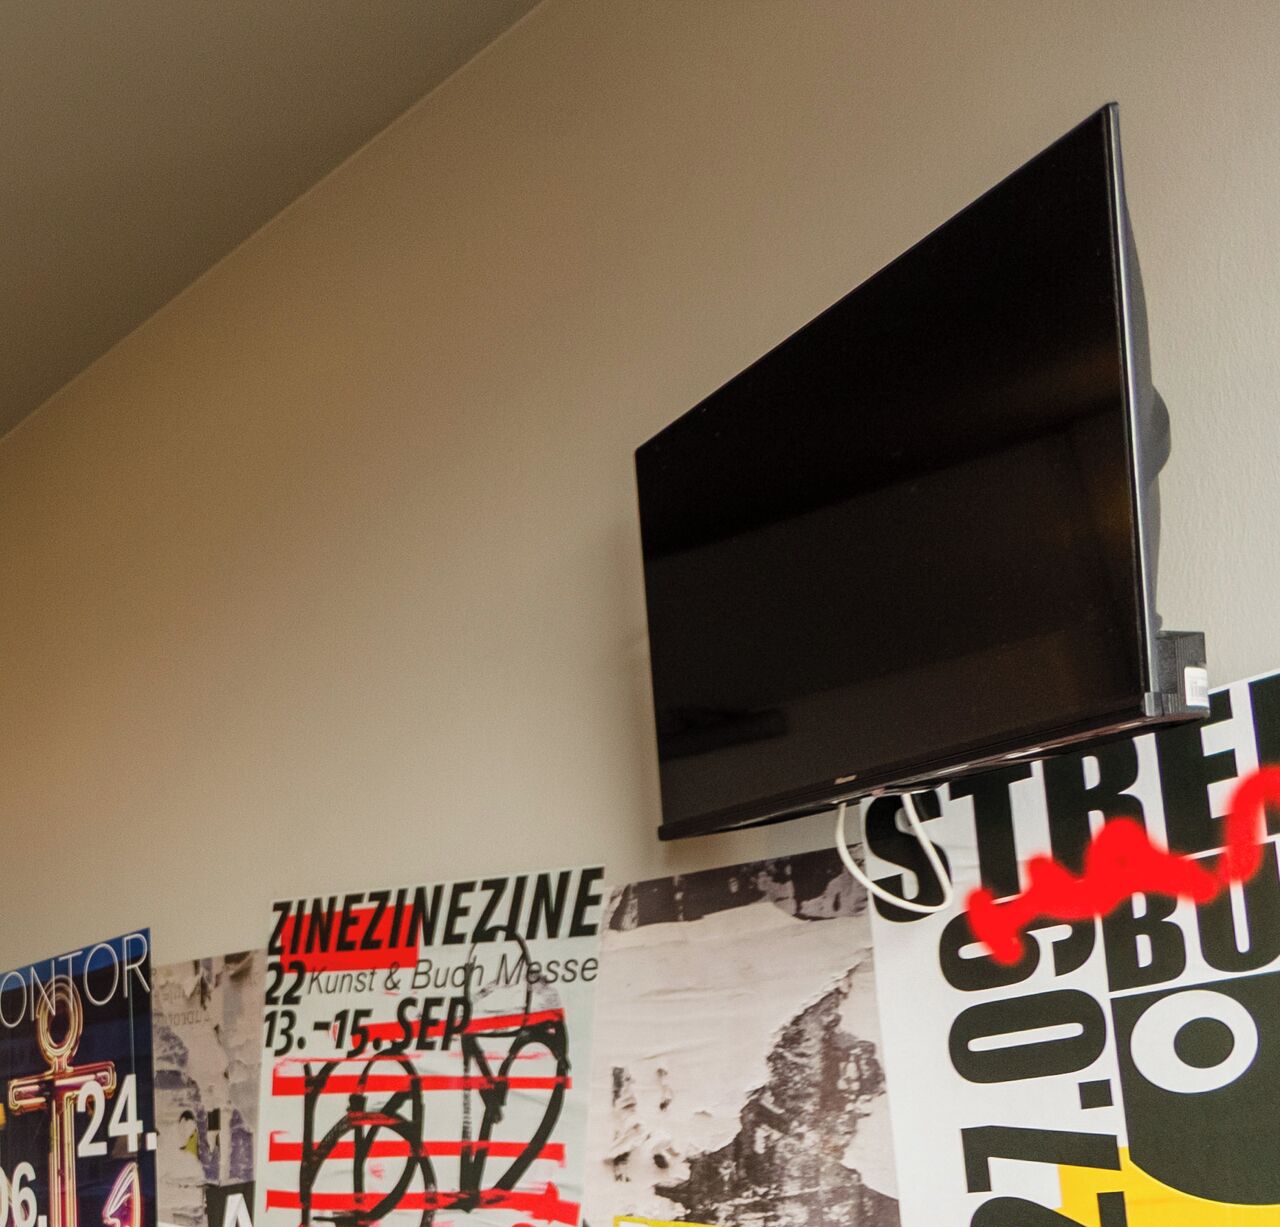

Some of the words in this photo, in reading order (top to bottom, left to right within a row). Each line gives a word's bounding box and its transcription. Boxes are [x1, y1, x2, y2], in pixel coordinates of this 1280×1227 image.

[268, 867, 605, 956] ZINEZINEZINE
[264, 959, 307, 1006] 22
[308, 966, 378, 995] Kunst
[384, 961, 402, 991] &
[411, 959, 485, 991] Buch
[495, 953, 600, 987] Messe
[393, 996, 474, 1052] SEP
[76, 1073, 158, 1159] 24.
